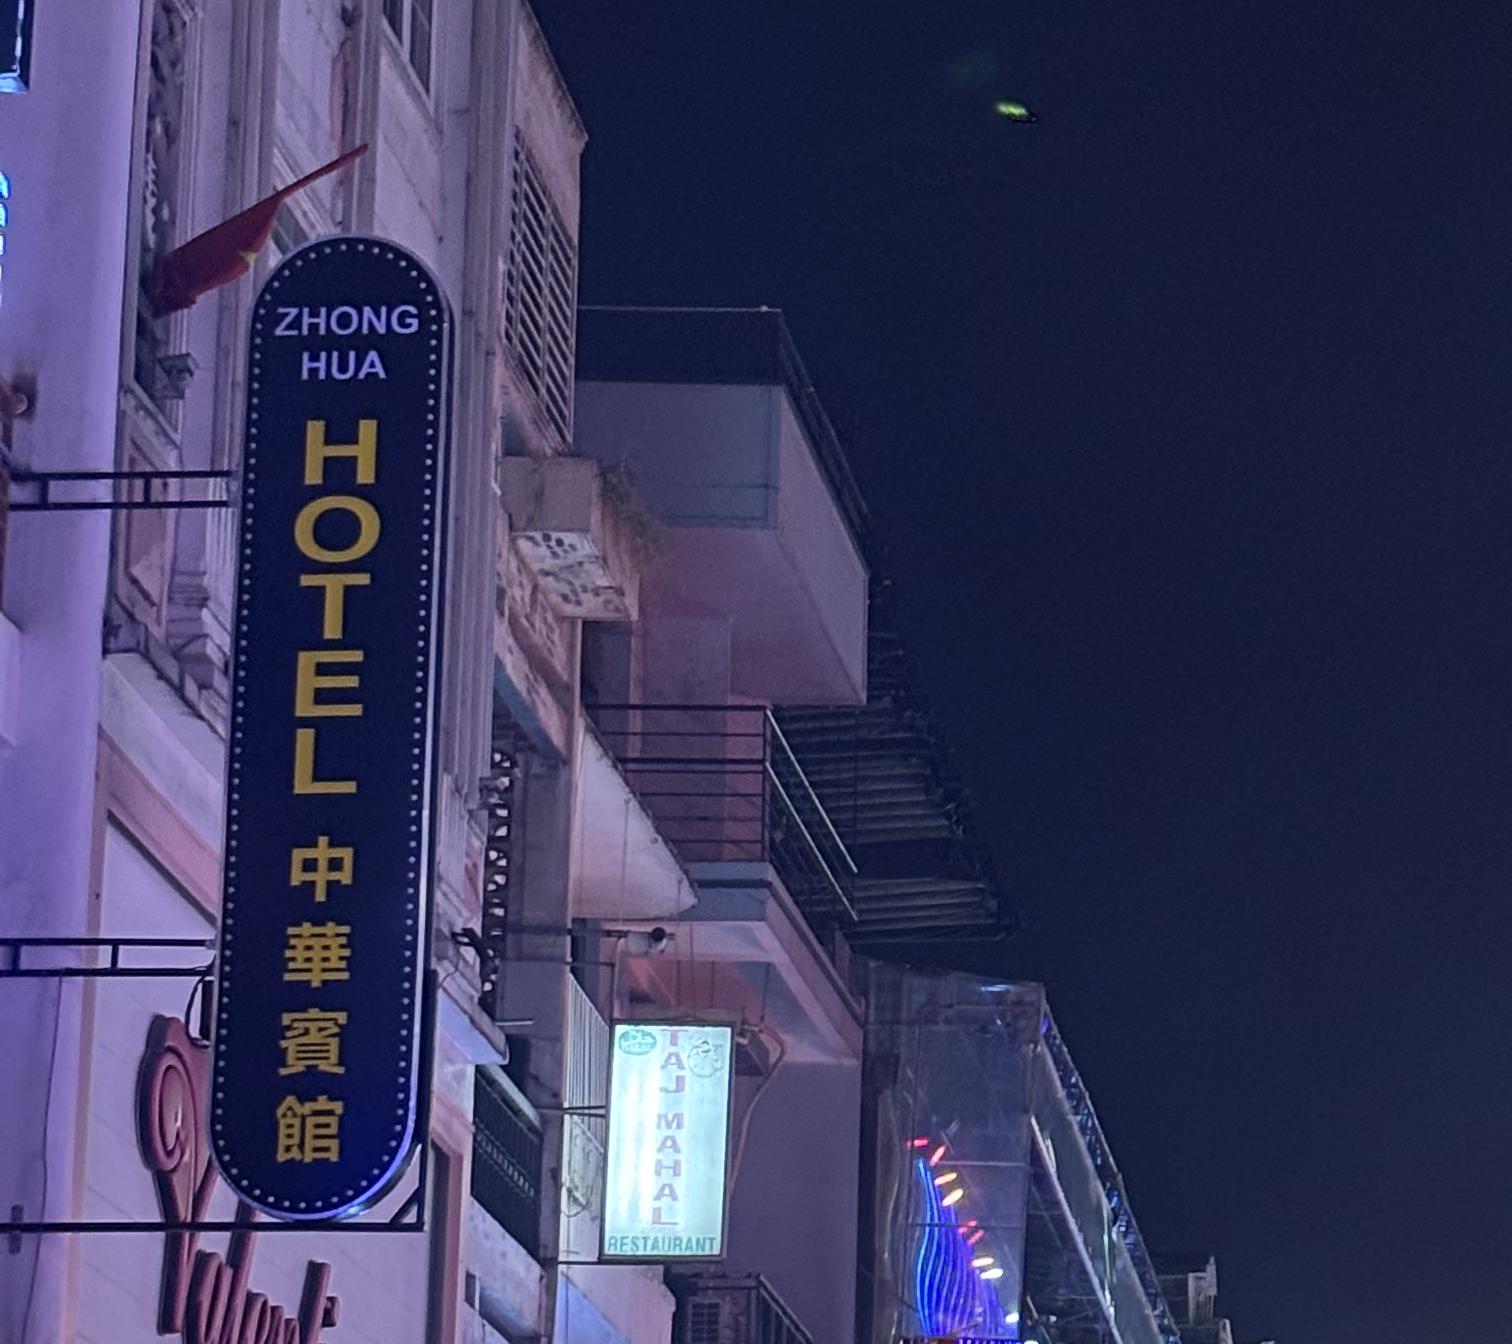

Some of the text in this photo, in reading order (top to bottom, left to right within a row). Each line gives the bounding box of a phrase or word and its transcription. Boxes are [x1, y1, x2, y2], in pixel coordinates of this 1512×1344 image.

[273, 306, 421, 337] ZHONG
[300, 350, 387, 381] HUA
[290, 419, 382, 796] HOTEL
[275, 835, 354, 1164] 中華賓館
[651, 1029, 689, 1226] TAJ MAHAL
[607, 1235, 716, 1253] RESTAURANT
